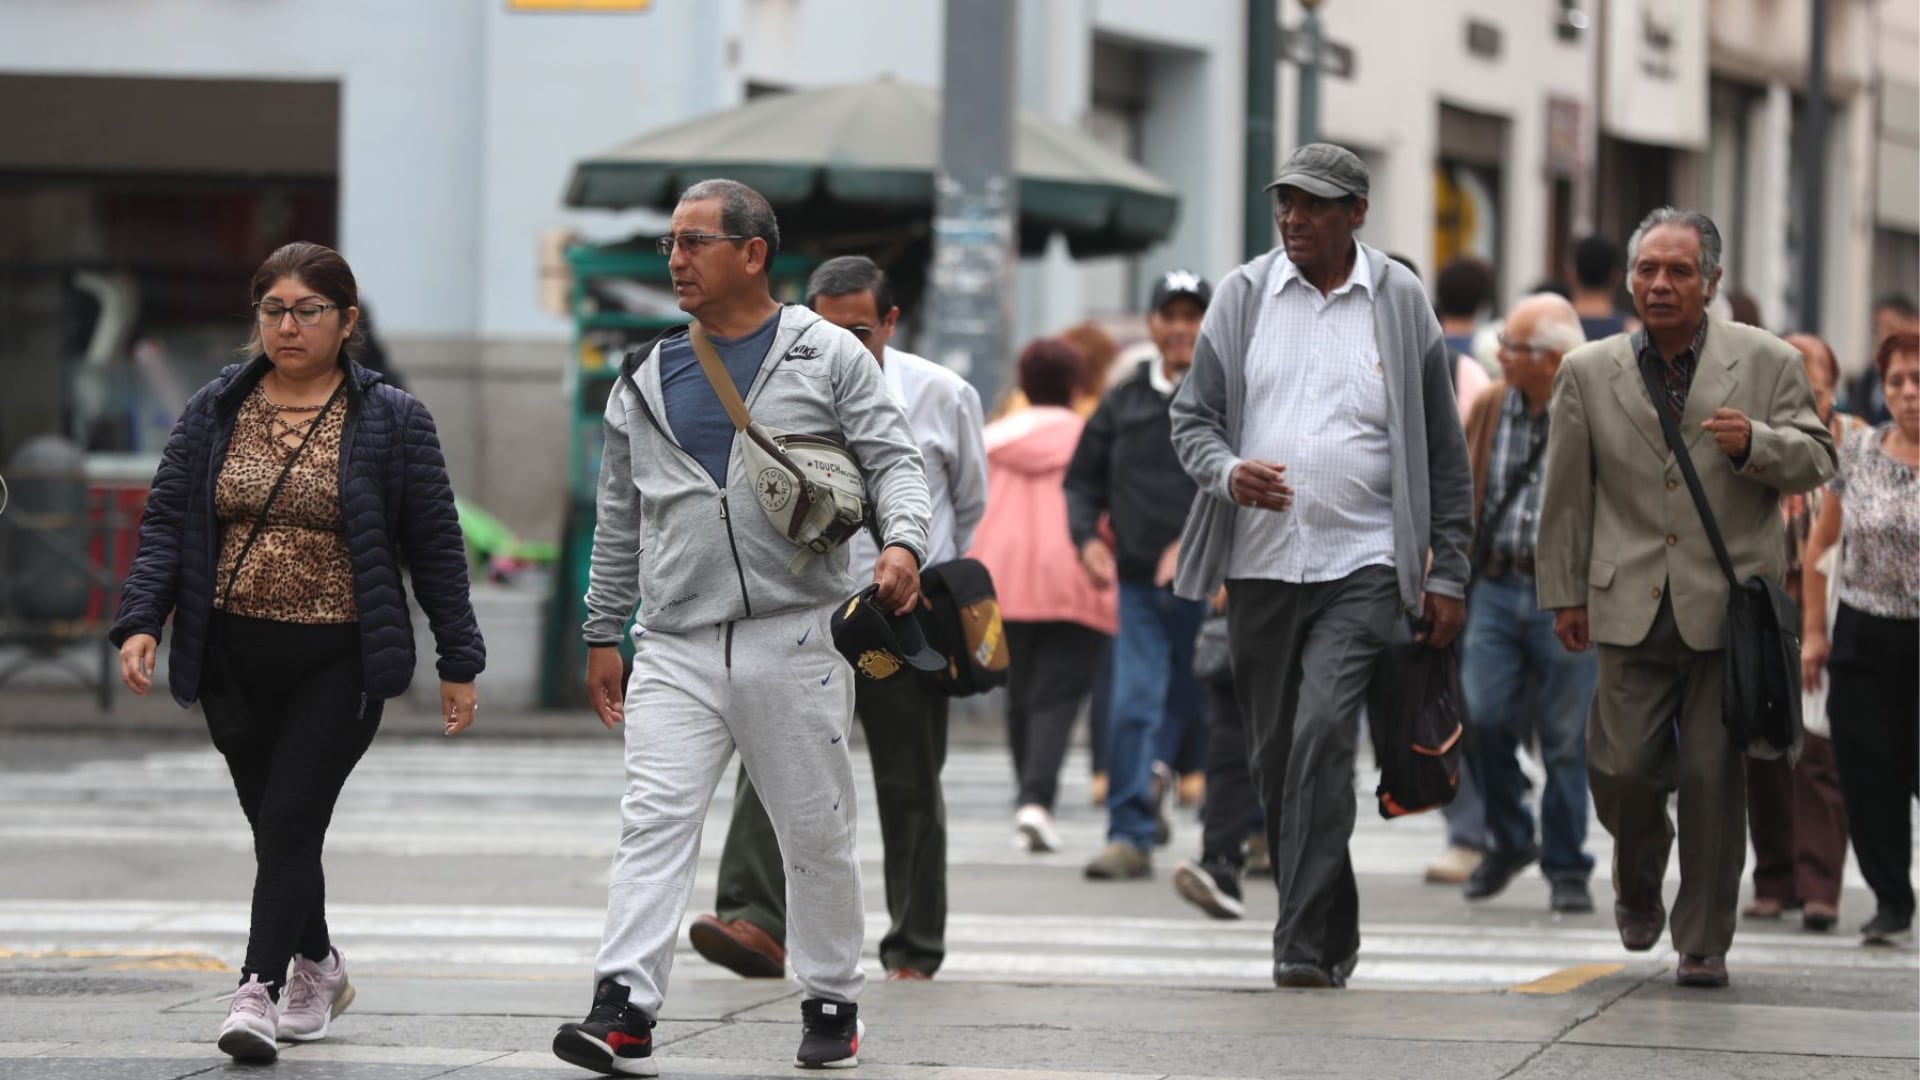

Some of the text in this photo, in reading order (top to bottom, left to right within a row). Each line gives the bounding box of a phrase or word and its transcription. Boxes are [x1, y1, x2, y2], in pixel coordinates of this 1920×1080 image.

[791, 344, 817, 357] NIKE
[814, 459, 841, 473] TOUCH
[765, 470, 788, 494] TOUCH
